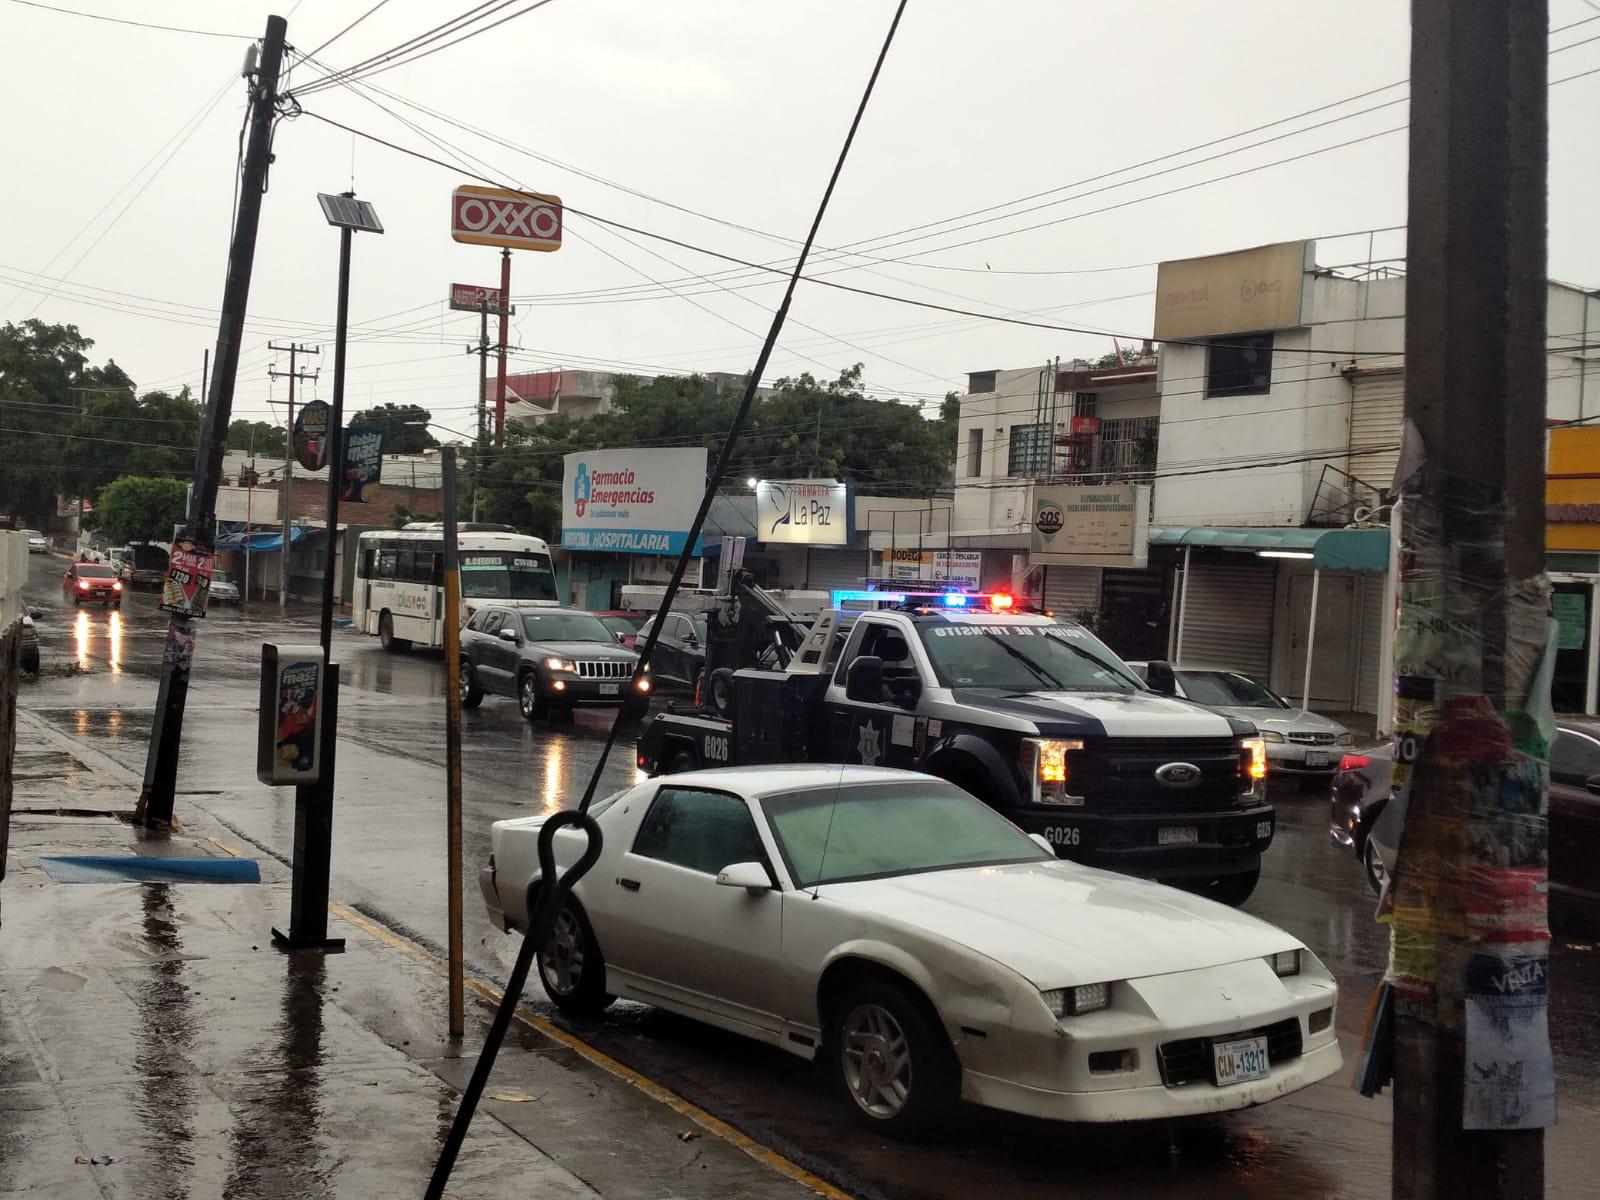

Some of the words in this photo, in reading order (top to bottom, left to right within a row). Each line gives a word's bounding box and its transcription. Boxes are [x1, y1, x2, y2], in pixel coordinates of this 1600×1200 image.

[460, 199, 559, 238] OXXO
[591, 469, 635, 486] Farmacia
[590, 487, 655, 508] Emergencias
[794, 486, 830, 497] FARMACIA
[794, 500, 808, 526] La
[811, 499, 832, 526] Paz
[1039, 511, 1060, 525] SOS
[592, 532, 670, 551] HOSPITALARIA
[891, 550, 923, 562] BODEGA
[704, 735, 728, 761] G026
[1044, 826, 1080, 846] G026
[1218, 1048, 1265, 1078] CLN-13217
